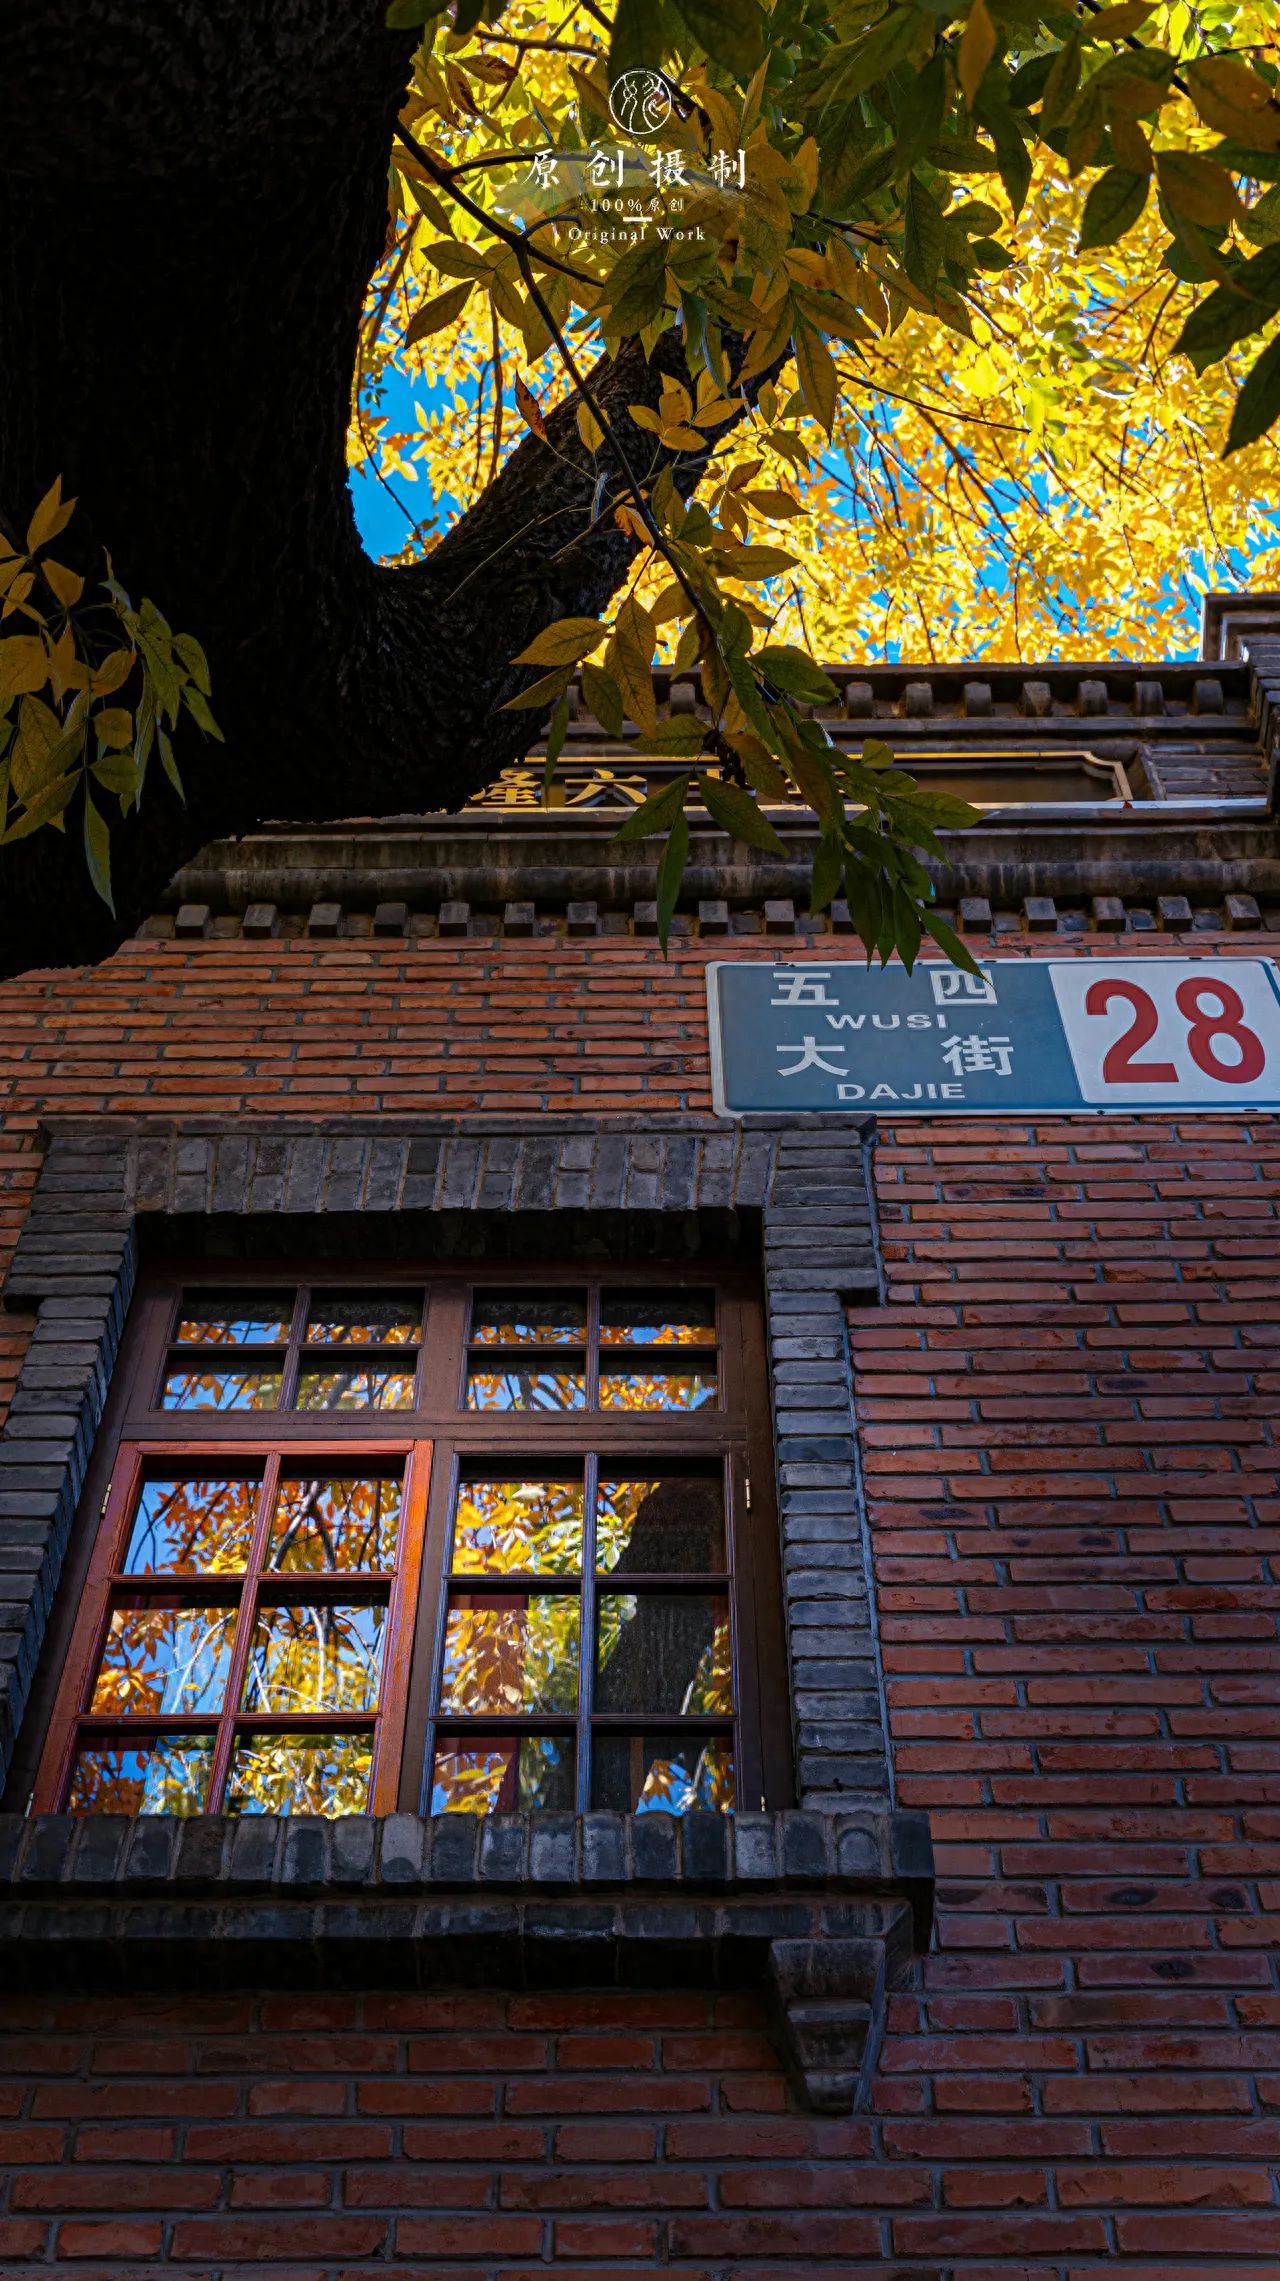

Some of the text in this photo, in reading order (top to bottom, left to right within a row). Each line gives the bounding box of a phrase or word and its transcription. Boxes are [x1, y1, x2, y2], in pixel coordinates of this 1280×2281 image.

[825, 1013, 947, 1030] WUSI
[1085, 976, 1267, 1085] 28
[837, 1083, 966, 1100] DAJIE
